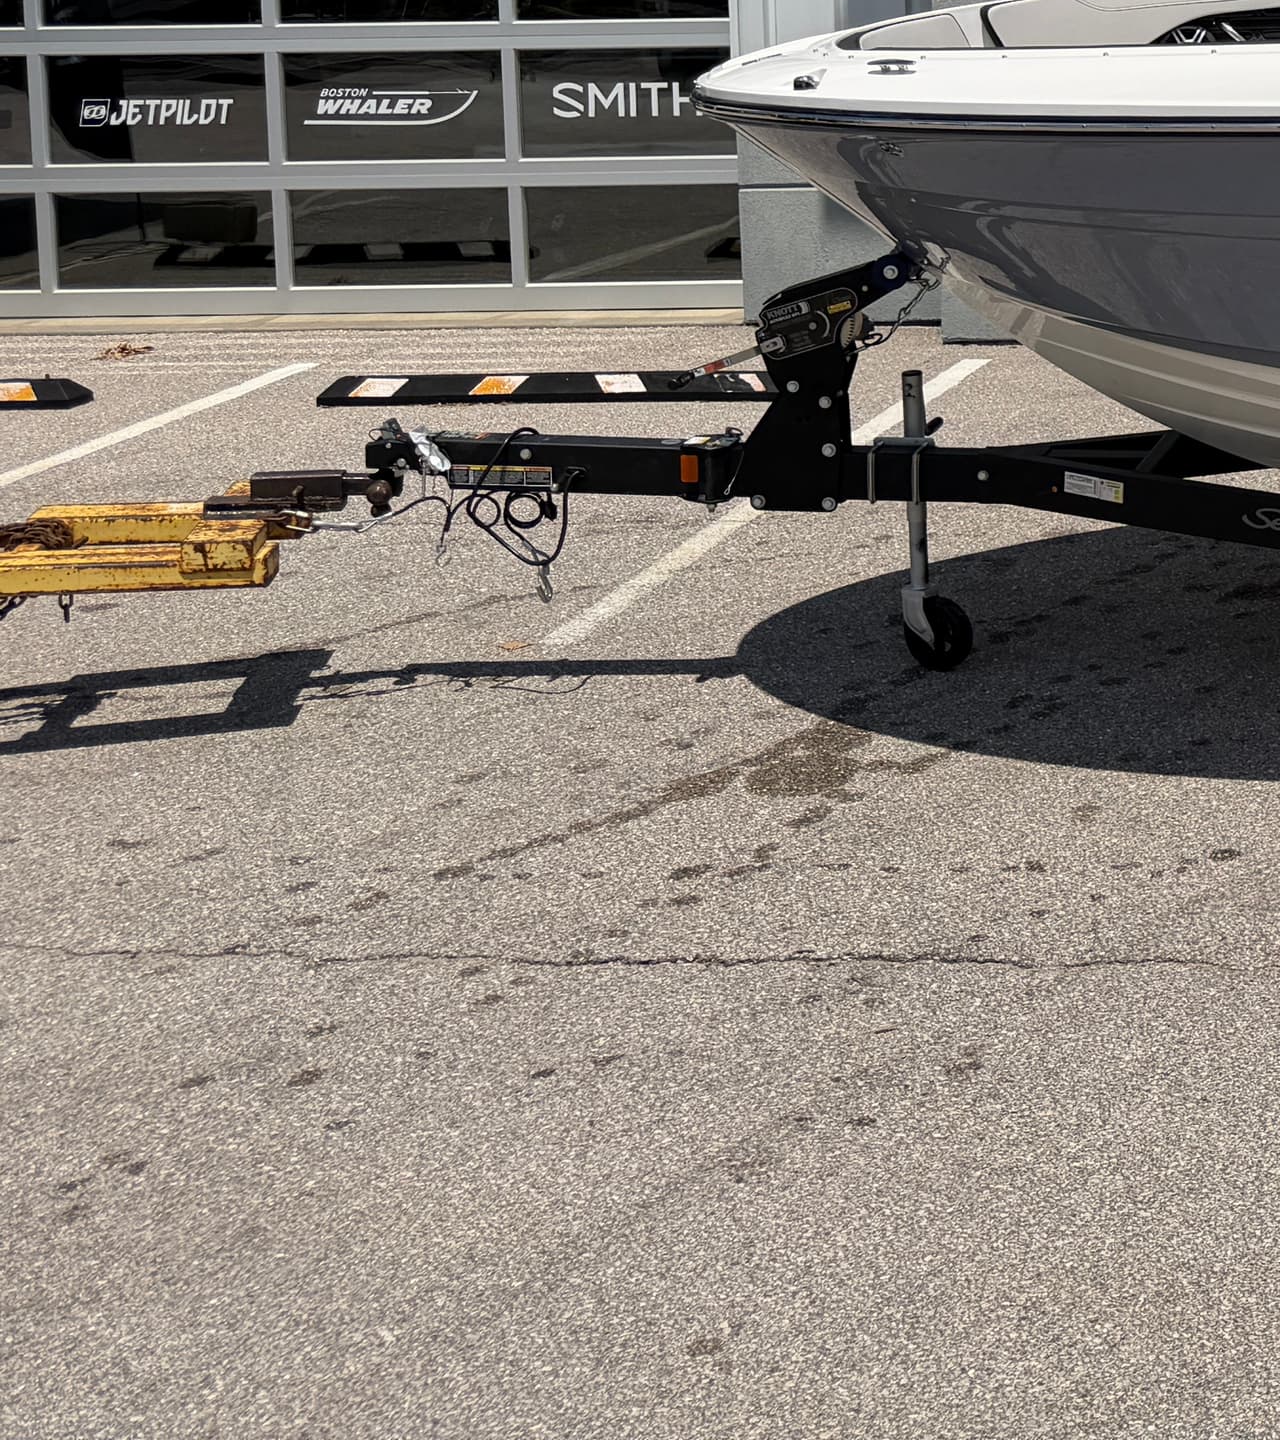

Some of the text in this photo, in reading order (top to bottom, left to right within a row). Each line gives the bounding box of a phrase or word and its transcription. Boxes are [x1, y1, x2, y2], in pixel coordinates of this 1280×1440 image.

[320, 88, 368, 97] BOSTON
[110, 98, 234, 125] JETPILOT
[317, 99, 432, 114] WHALER
